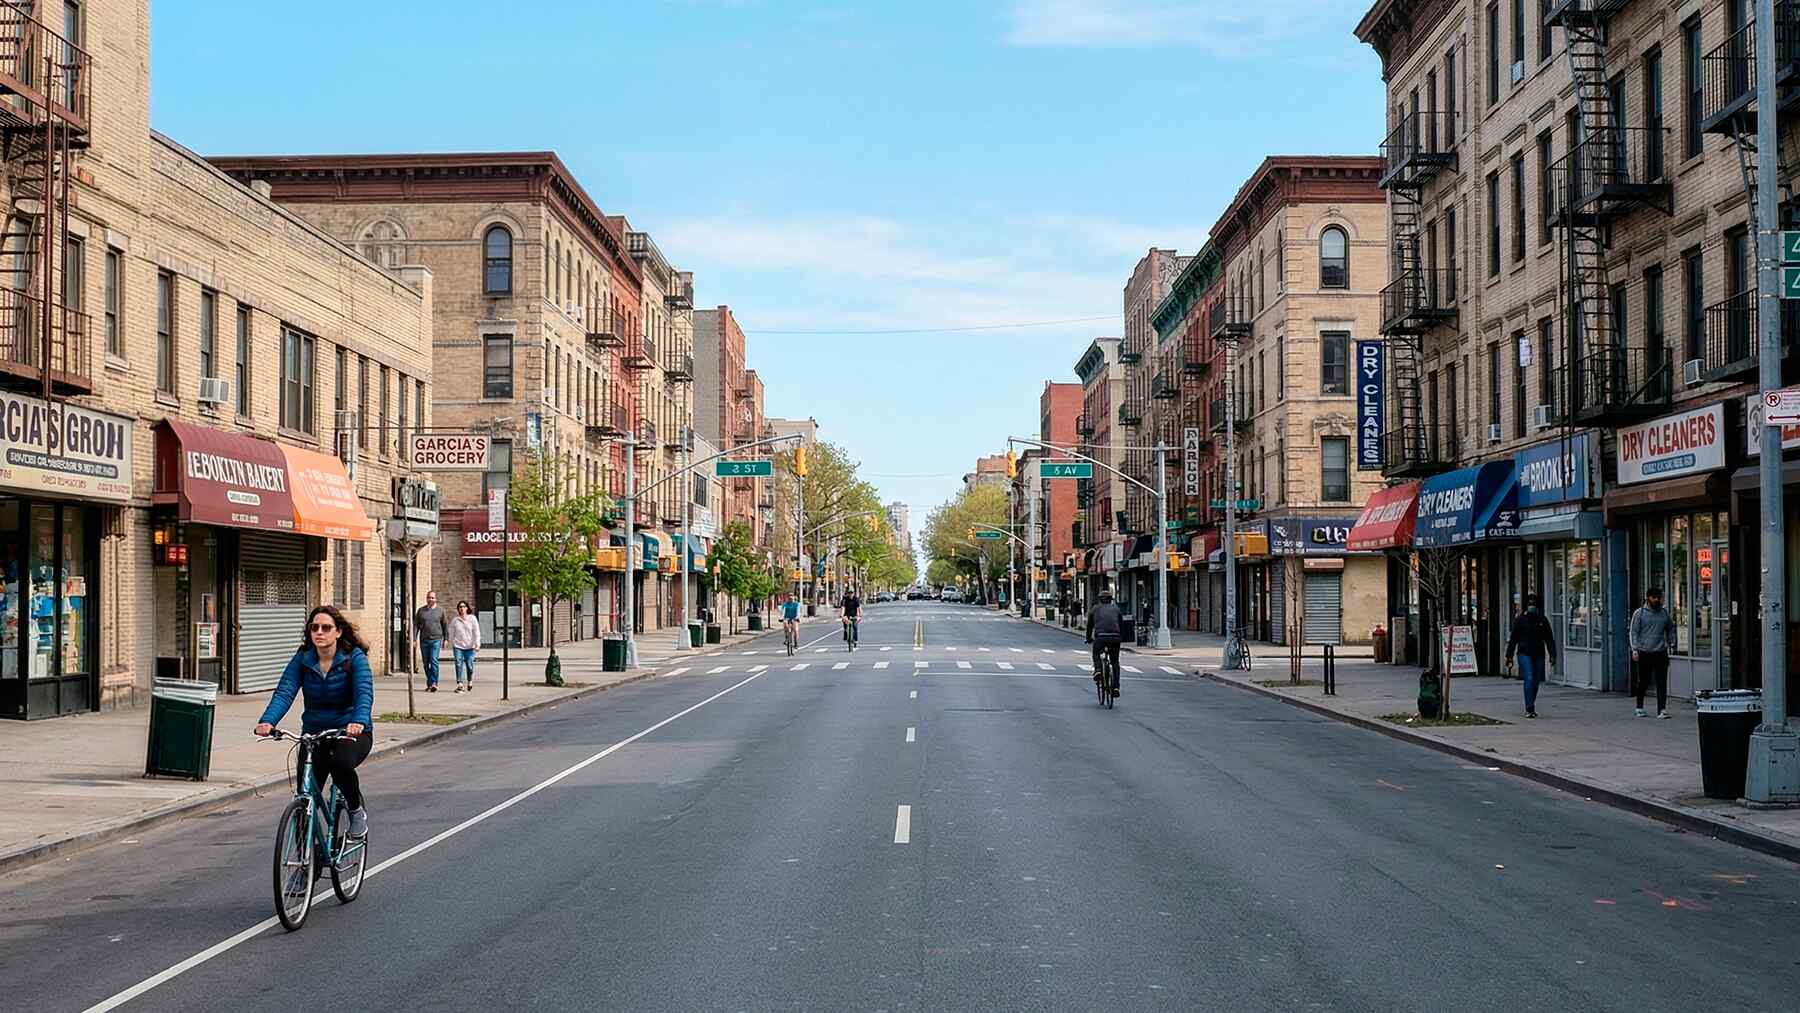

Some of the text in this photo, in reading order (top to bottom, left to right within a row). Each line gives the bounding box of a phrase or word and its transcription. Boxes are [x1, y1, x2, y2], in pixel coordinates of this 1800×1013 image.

[1363, 346, 1379, 379] DRY
[415, 438, 486, 450] GARCIA'S
[1622, 430, 1645, 462] DRY
[1648, 412, 1716, 457] CLEANERS
[415, 452, 485, 464] GROCERY
[744, 464, 757, 473] ST
[1064, 466, 1077, 475] AV
[1530, 453, 1577, 493] BROOKL
[245, 462, 286, 493] BAKERY
[1436, 485, 1474, 515] CLEANERS
